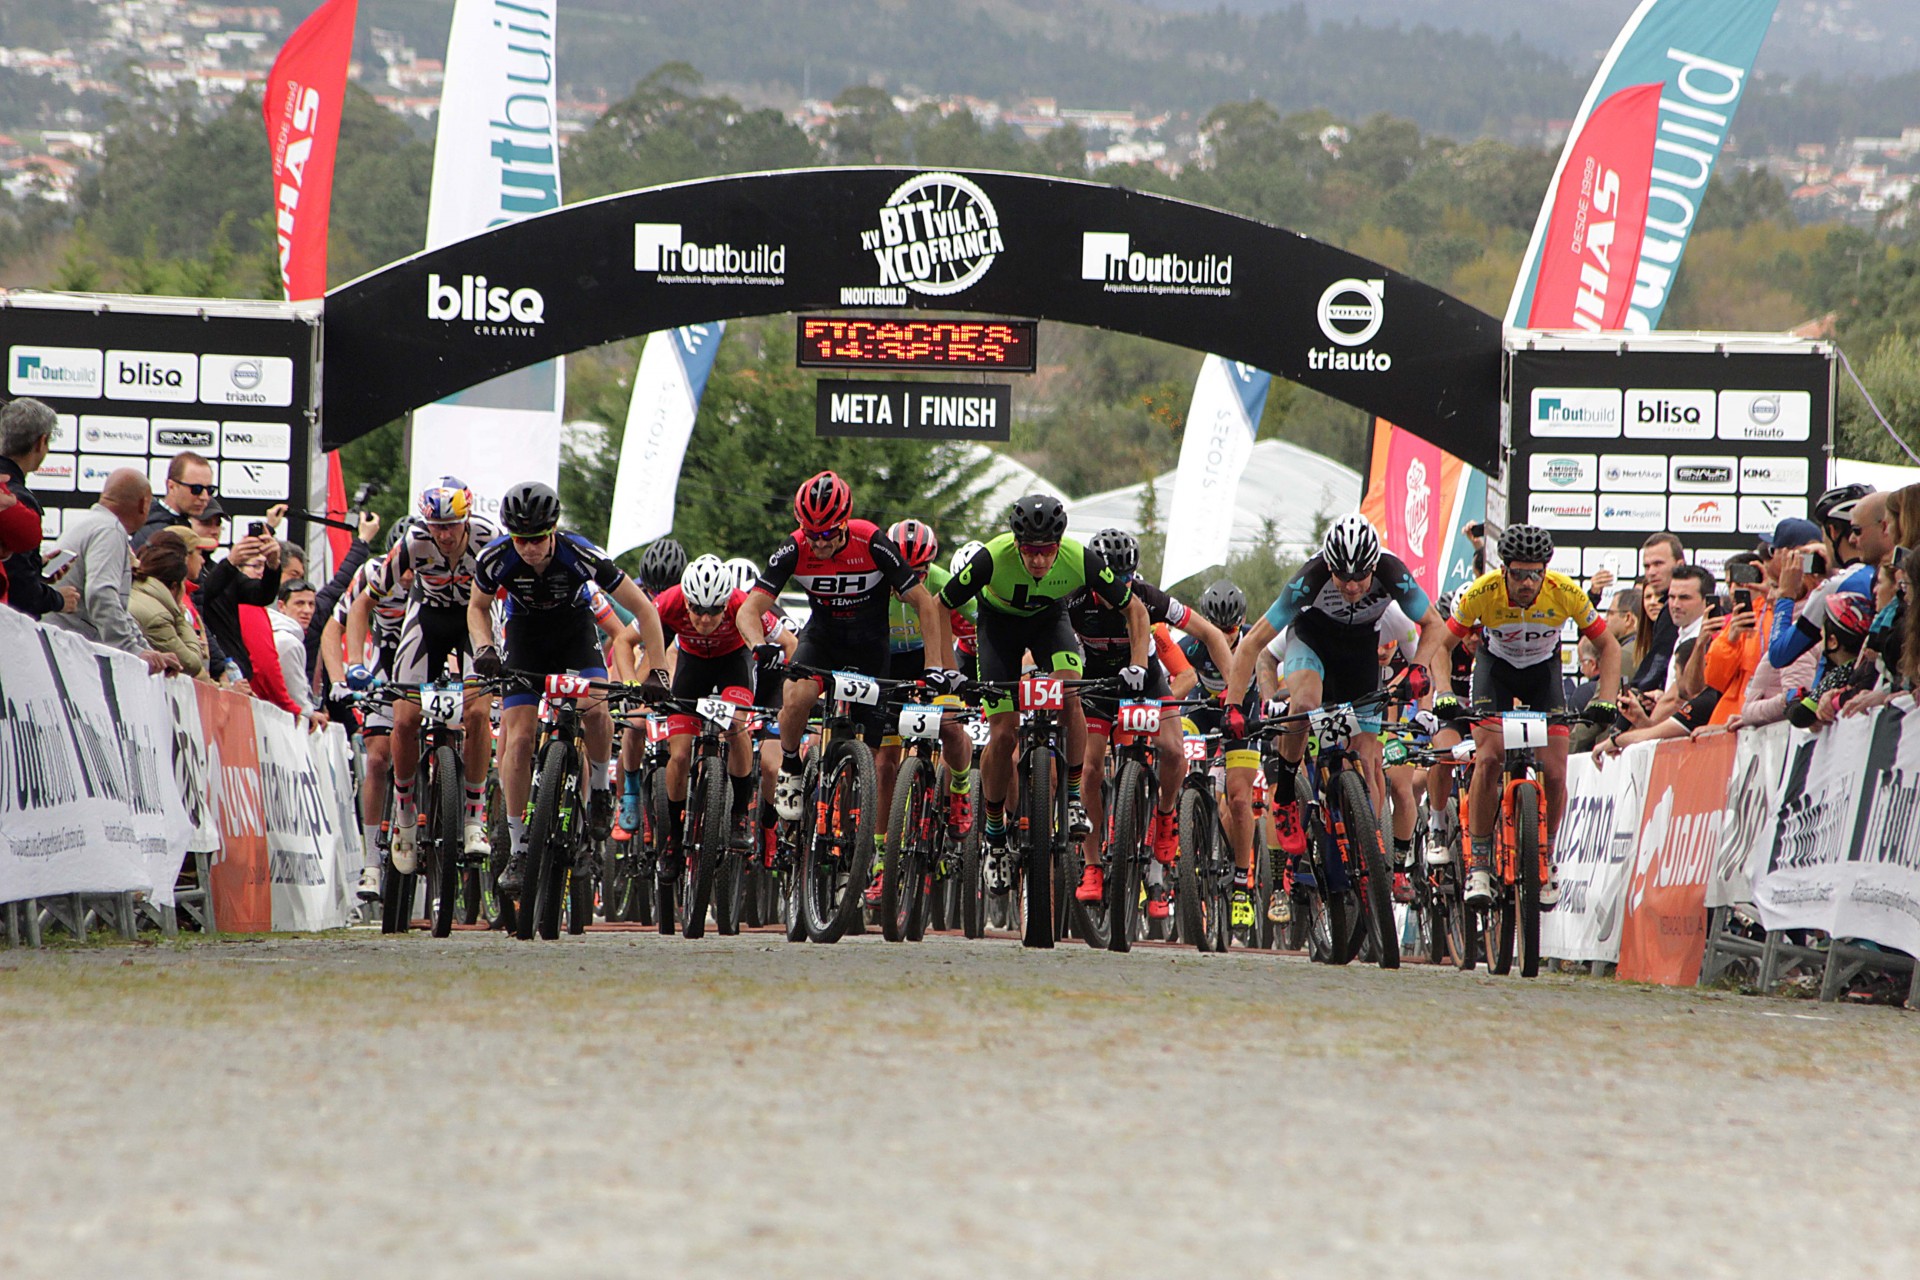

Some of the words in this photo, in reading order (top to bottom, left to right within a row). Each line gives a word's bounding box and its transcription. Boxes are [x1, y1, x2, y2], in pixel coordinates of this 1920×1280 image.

[861, 229, 880, 250] XV
[879, 200, 935, 246] BTT
[933, 205, 980, 240] VILA
[1571, 199, 1590, 255] DESDE
[874, 241, 931, 286] XCO
[928, 227, 1004, 264] FRANCA
[657, 274, 700, 284] Arquitectura
[702, 275, 742, 286] Engenharia
[744, 276, 785, 287] Construção
[1104, 283, 1147, 294] Arquitectura
[1149, 284, 1188, 295] Engenharia
[1190, 286, 1231, 297] Construção
[840, 287, 907, 306] INOUTBUILD
[1329, 308, 1373, 318] VOLVO
[473, 325, 536, 337] CREATIVE
[1307, 347, 1392, 372] triauto
[225, 391, 267, 403] triauto
[831, 393, 893, 425] META
[920, 396, 997, 428] FINISH
[1743, 427, 1785, 439] triauto
[1683, 515, 1722, 523] unium
[811, 576, 867, 593] BH
[1022, 680, 1063, 707] 154
[430, 695, 455, 720] 43
[704, 701, 728, 721] 38
[912, 713, 927, 734] 3
[1121, 708, 1160, 733] 108
[1519, 721, 1529, 743] 1
